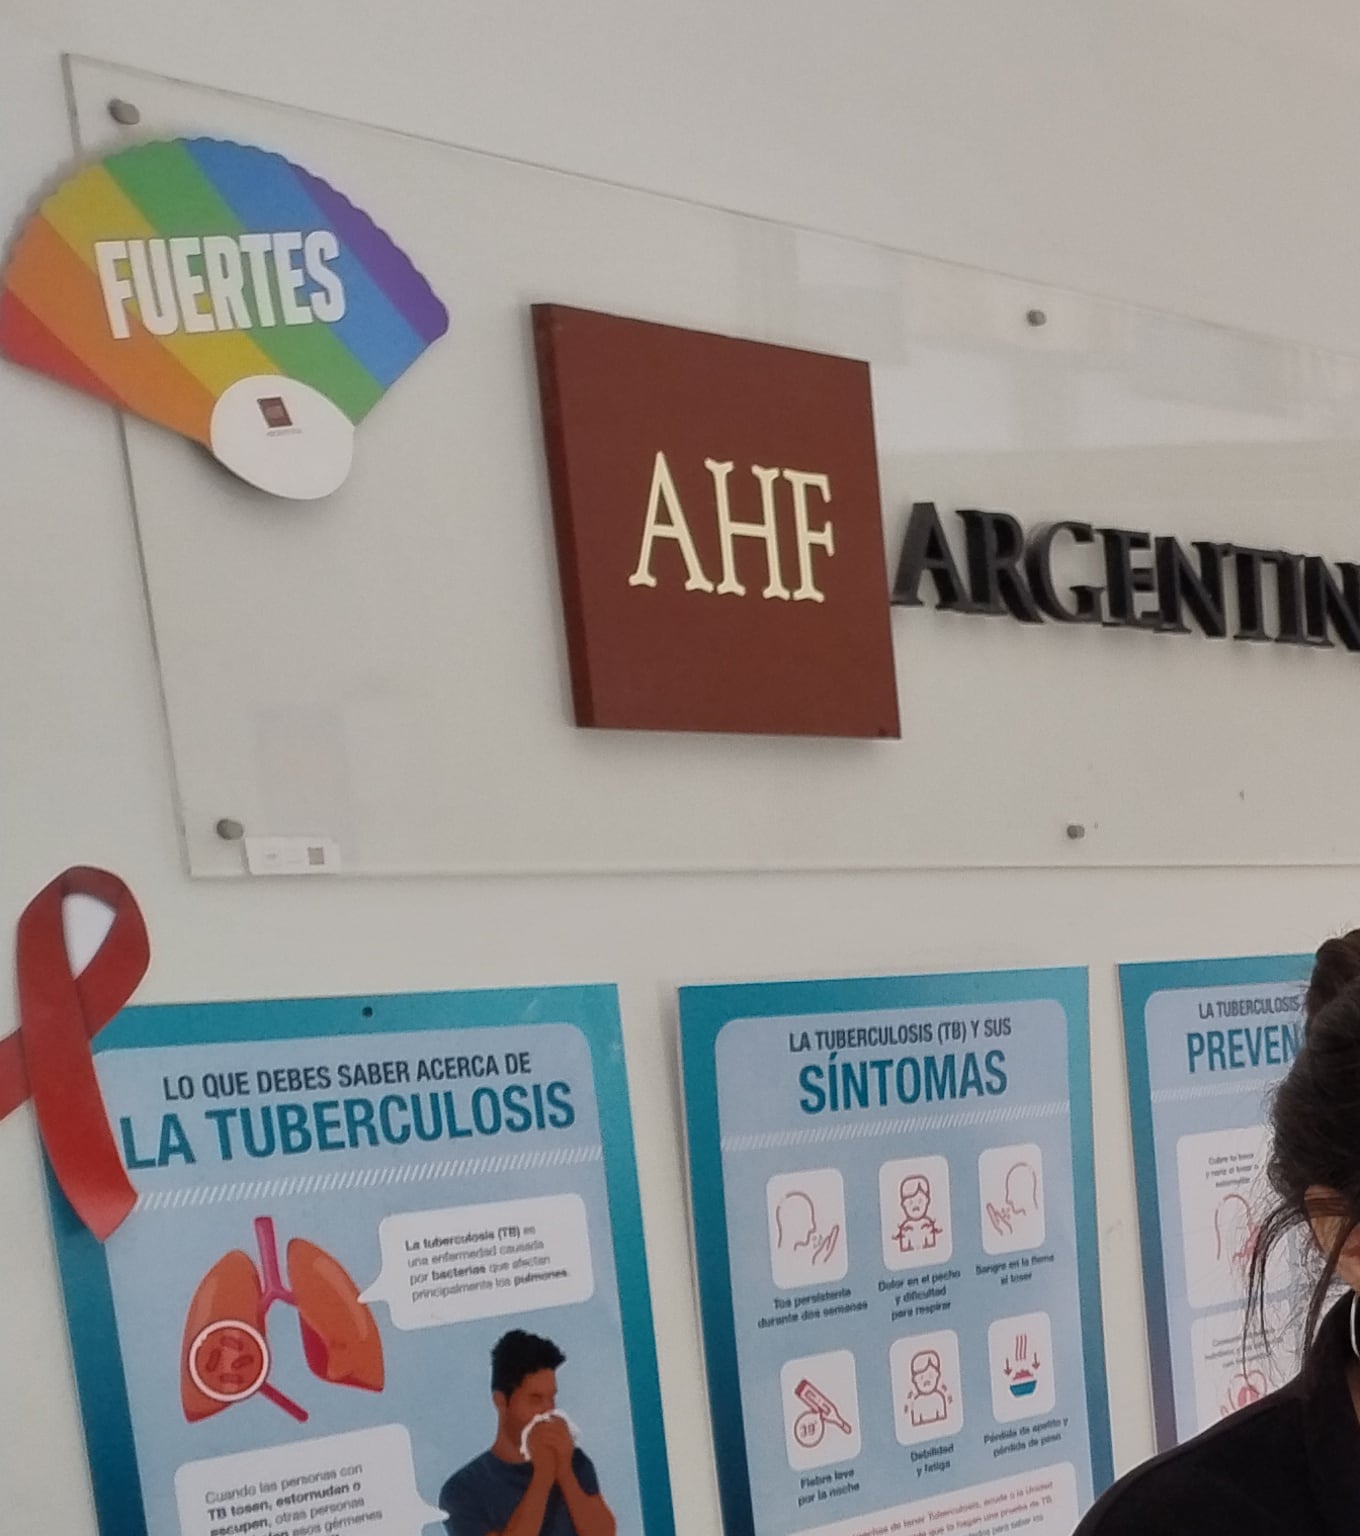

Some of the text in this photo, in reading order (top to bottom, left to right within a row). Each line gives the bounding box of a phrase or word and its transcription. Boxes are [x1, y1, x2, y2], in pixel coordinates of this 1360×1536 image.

[95, 231, 347, 341] FUERTES
[628, 451, 836, 604] AHF
[1199, 996, 1299, 1019] LA TUBERCULOSIS
[789, 1017, 1012, 1053] LA TUBERCULOSIS (TB) Y SUS
[163, 1051, 532, 1100] LO QUE DEBES SABER ACERCA DE
[799, 1050, 1008, 1114] SÍNTOMAS
[119, 1082, 576, 1170] LA TUBERCULOSIS
[405, 1240, 421, 1251] La
[423, 1230, 495, 1248] tuberculosis
[497, 1225, 520, 1239] (TB)
[410, 1273, 428, 1286] por
[431, 1264, 486, 1280] bacterias
[910, 1443, 954, 1462] Debilidad
[924, 1460, 951, 1472] fatiga
[205, 1466, 363, 1504] Cuando las personas con
[208, 1507, 227, 1521] TB
[276, 1485, 350, 1507] estornudan
[352, 1482, 361, 1492] o
[275, 1510, 307, 1524] otras
[310, 1498, 365, 1520] personas
[292, 1524, 322, 1536] esos
[324, 1512, 383, 1534] gérmenes
